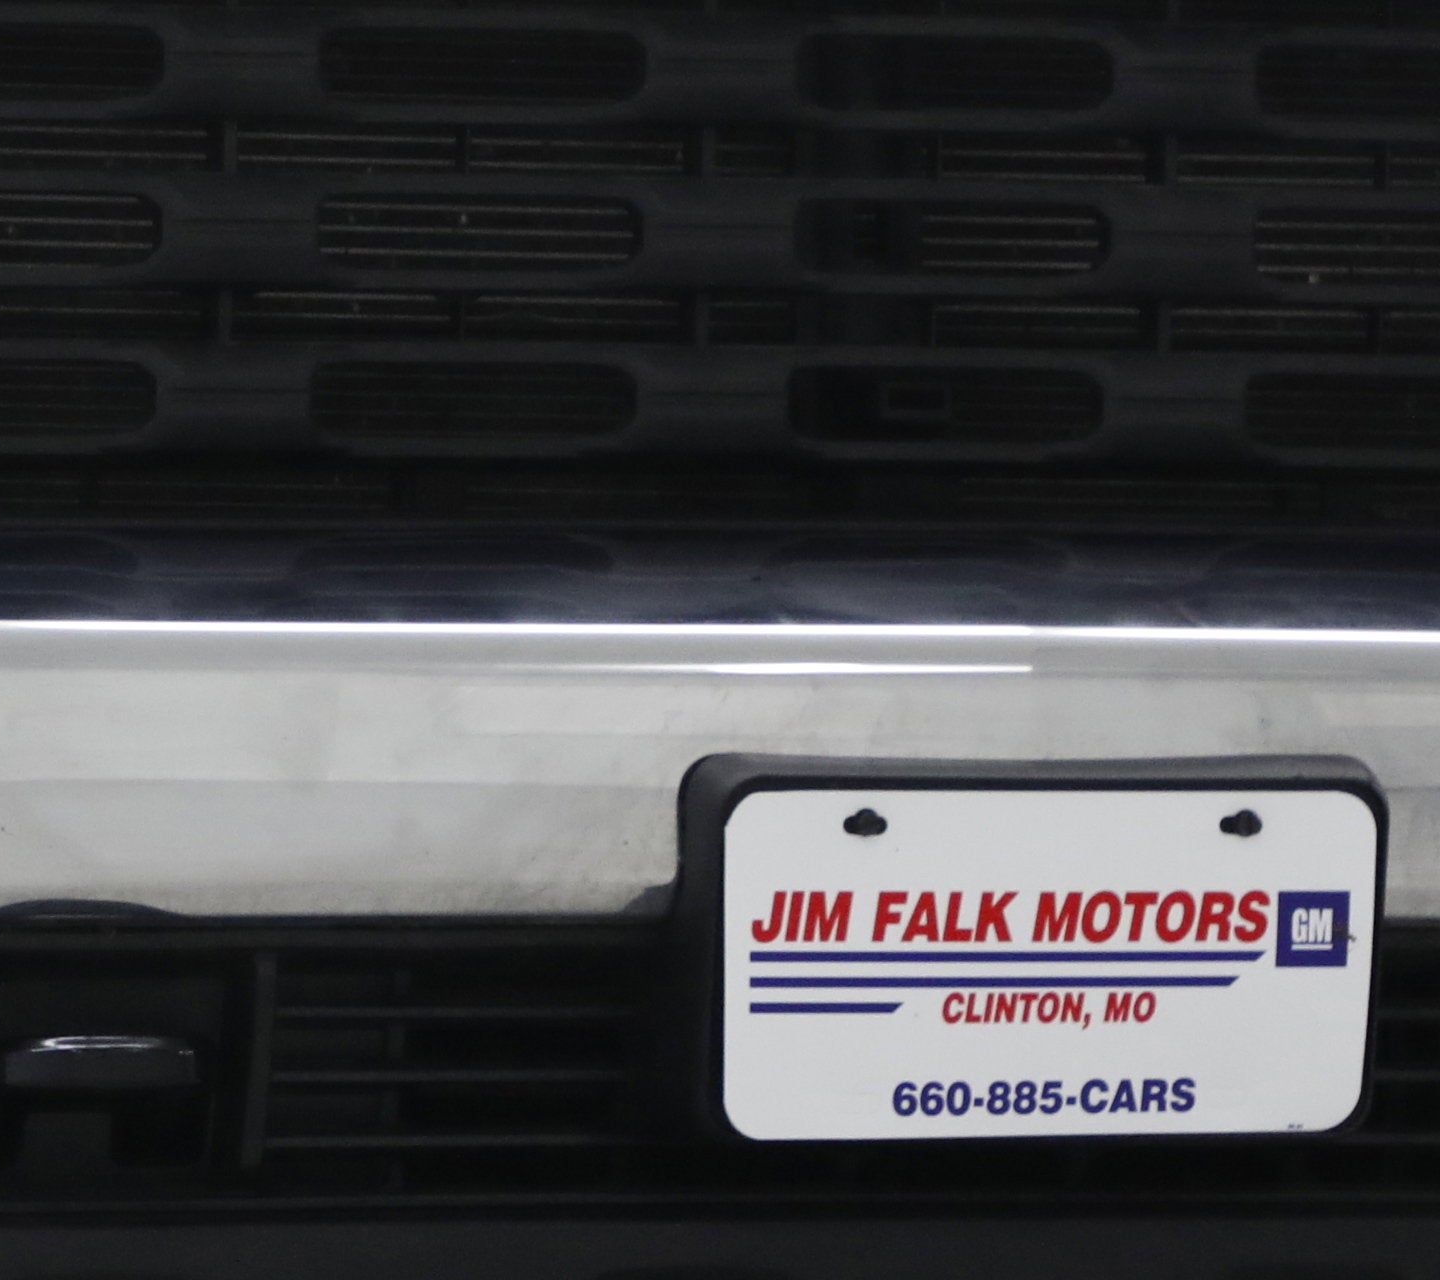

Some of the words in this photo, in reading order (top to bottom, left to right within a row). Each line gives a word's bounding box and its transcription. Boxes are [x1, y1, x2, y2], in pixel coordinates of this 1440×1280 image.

[751, 891, 853, 943] JIM
[872, 891, 1017, 943] FALK
[1032, 890, 1270, 944] MOTORS
[1291, 907, 1334, 944] GM
[942, 991, 1091, 1031] CLINTON,
[1104, 991, 1157, 1023] MO
[892, 1077, 1197, 1117] 660-885-CARS
